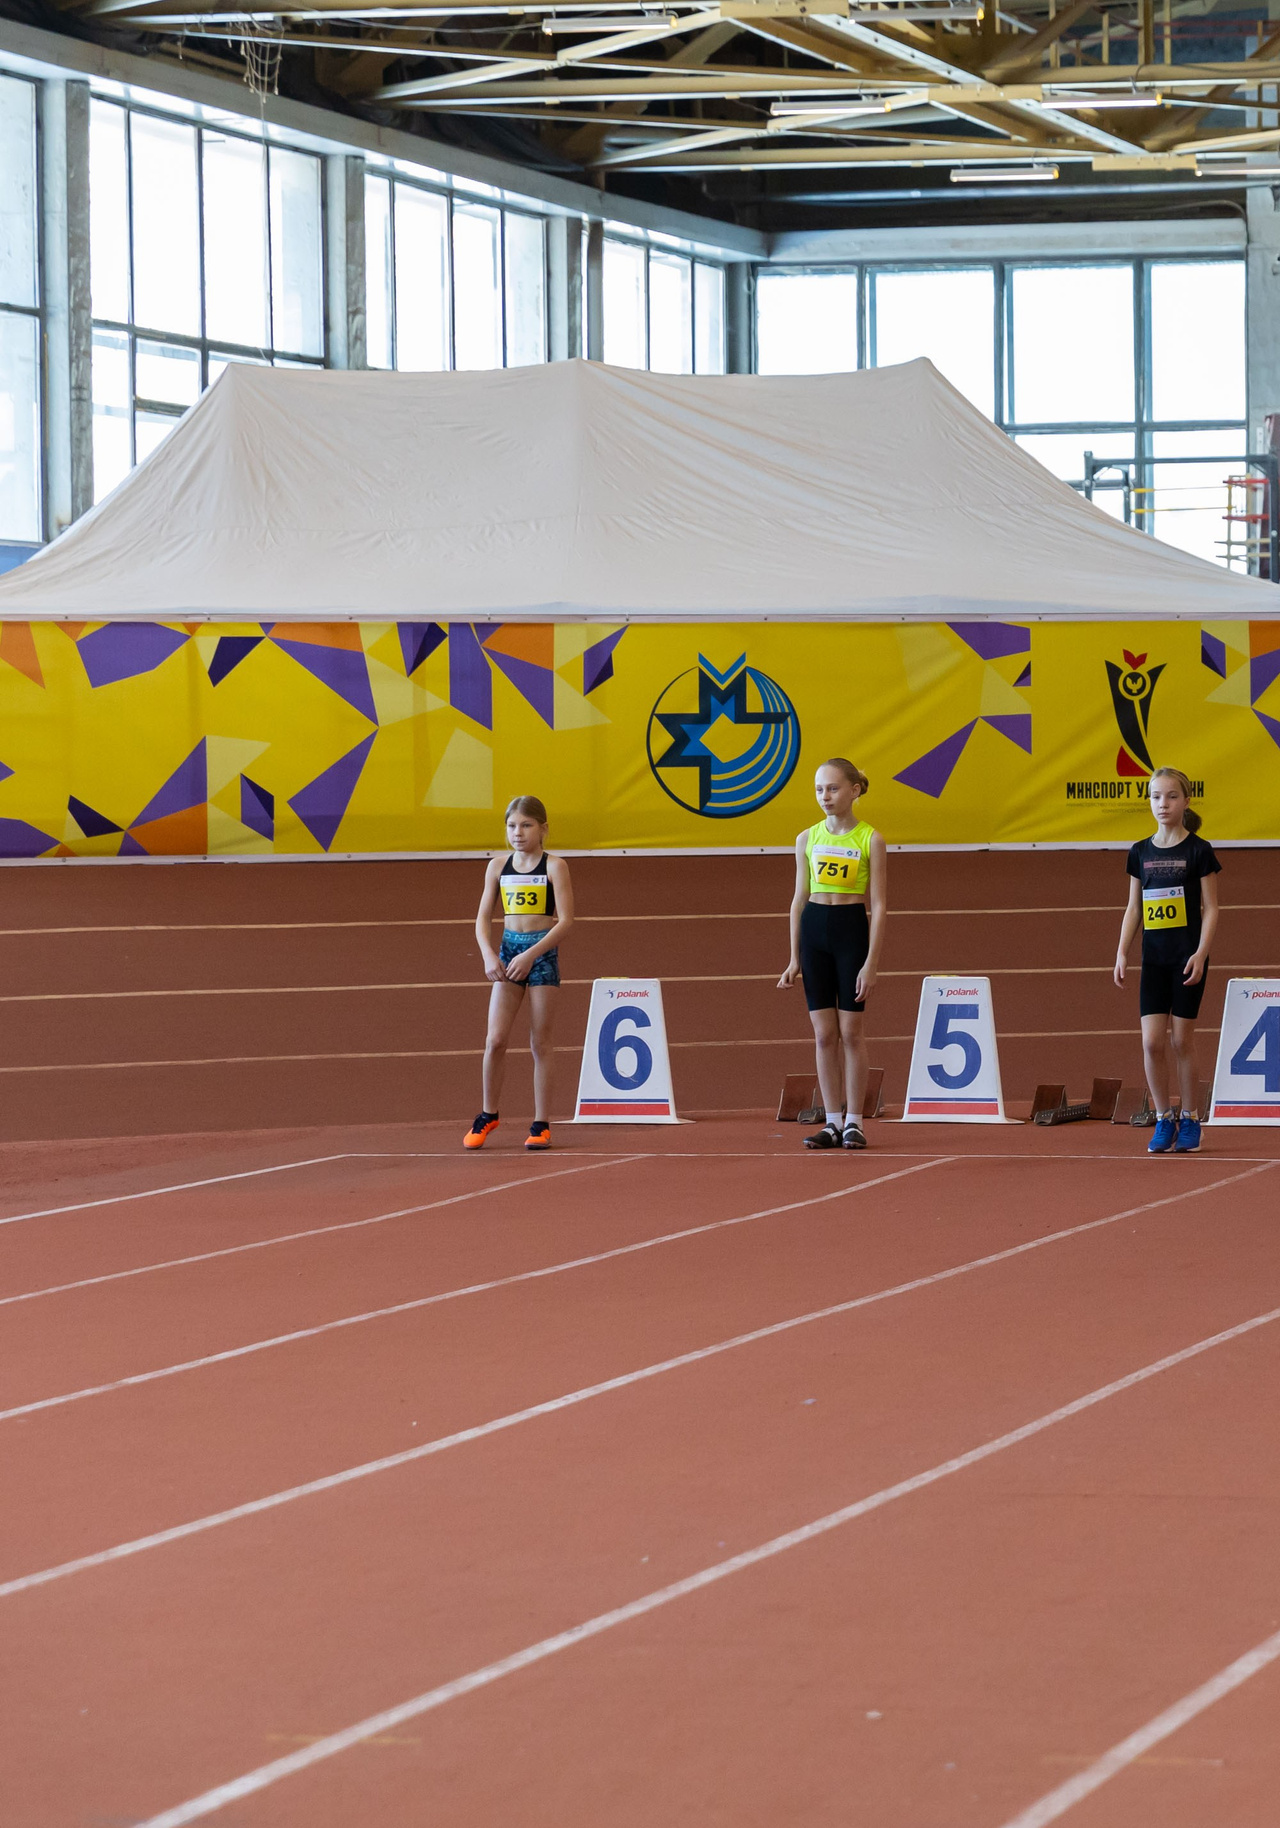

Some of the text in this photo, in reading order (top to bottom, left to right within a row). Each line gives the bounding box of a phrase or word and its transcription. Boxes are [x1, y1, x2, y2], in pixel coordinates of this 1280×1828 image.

[1066, 781, 1132, 799] МИНСПОРТ
[817, 861, 849, 878] 751
[505, 892, 538, 906] 753
[1147, 904, 1177, 921] 240
[617, 989, 649, 999] polanik
[946, 988, 979, 998] polanik
[598, 1005, 652, 1091] 6
[927, 1004, 982, 1090] 5
